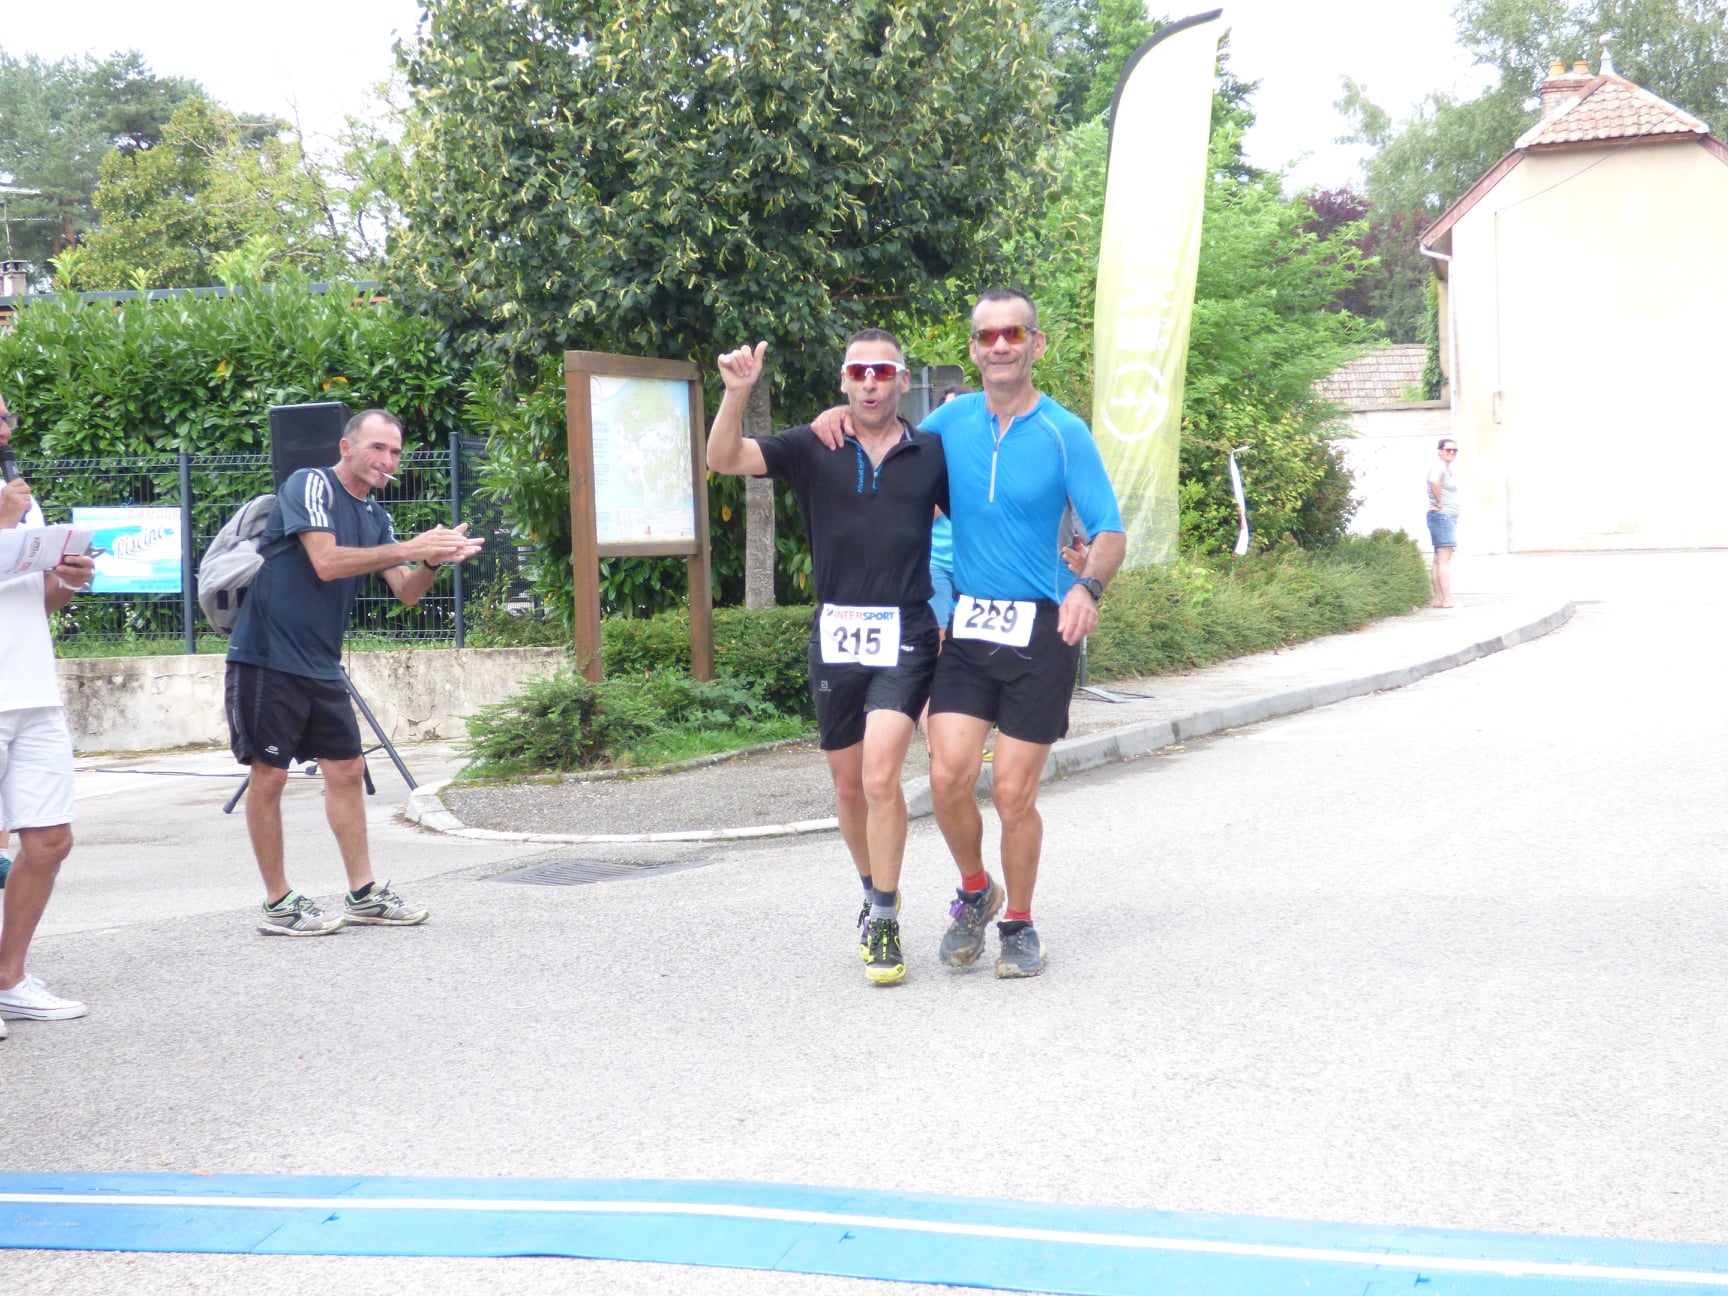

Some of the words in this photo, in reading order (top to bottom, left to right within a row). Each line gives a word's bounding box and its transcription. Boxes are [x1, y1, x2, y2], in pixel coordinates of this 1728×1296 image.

[834, 610, 894, 621] INTERSPORT
[964, 602, 1018, 633] 229
[833, 626, 881, 655] 215
